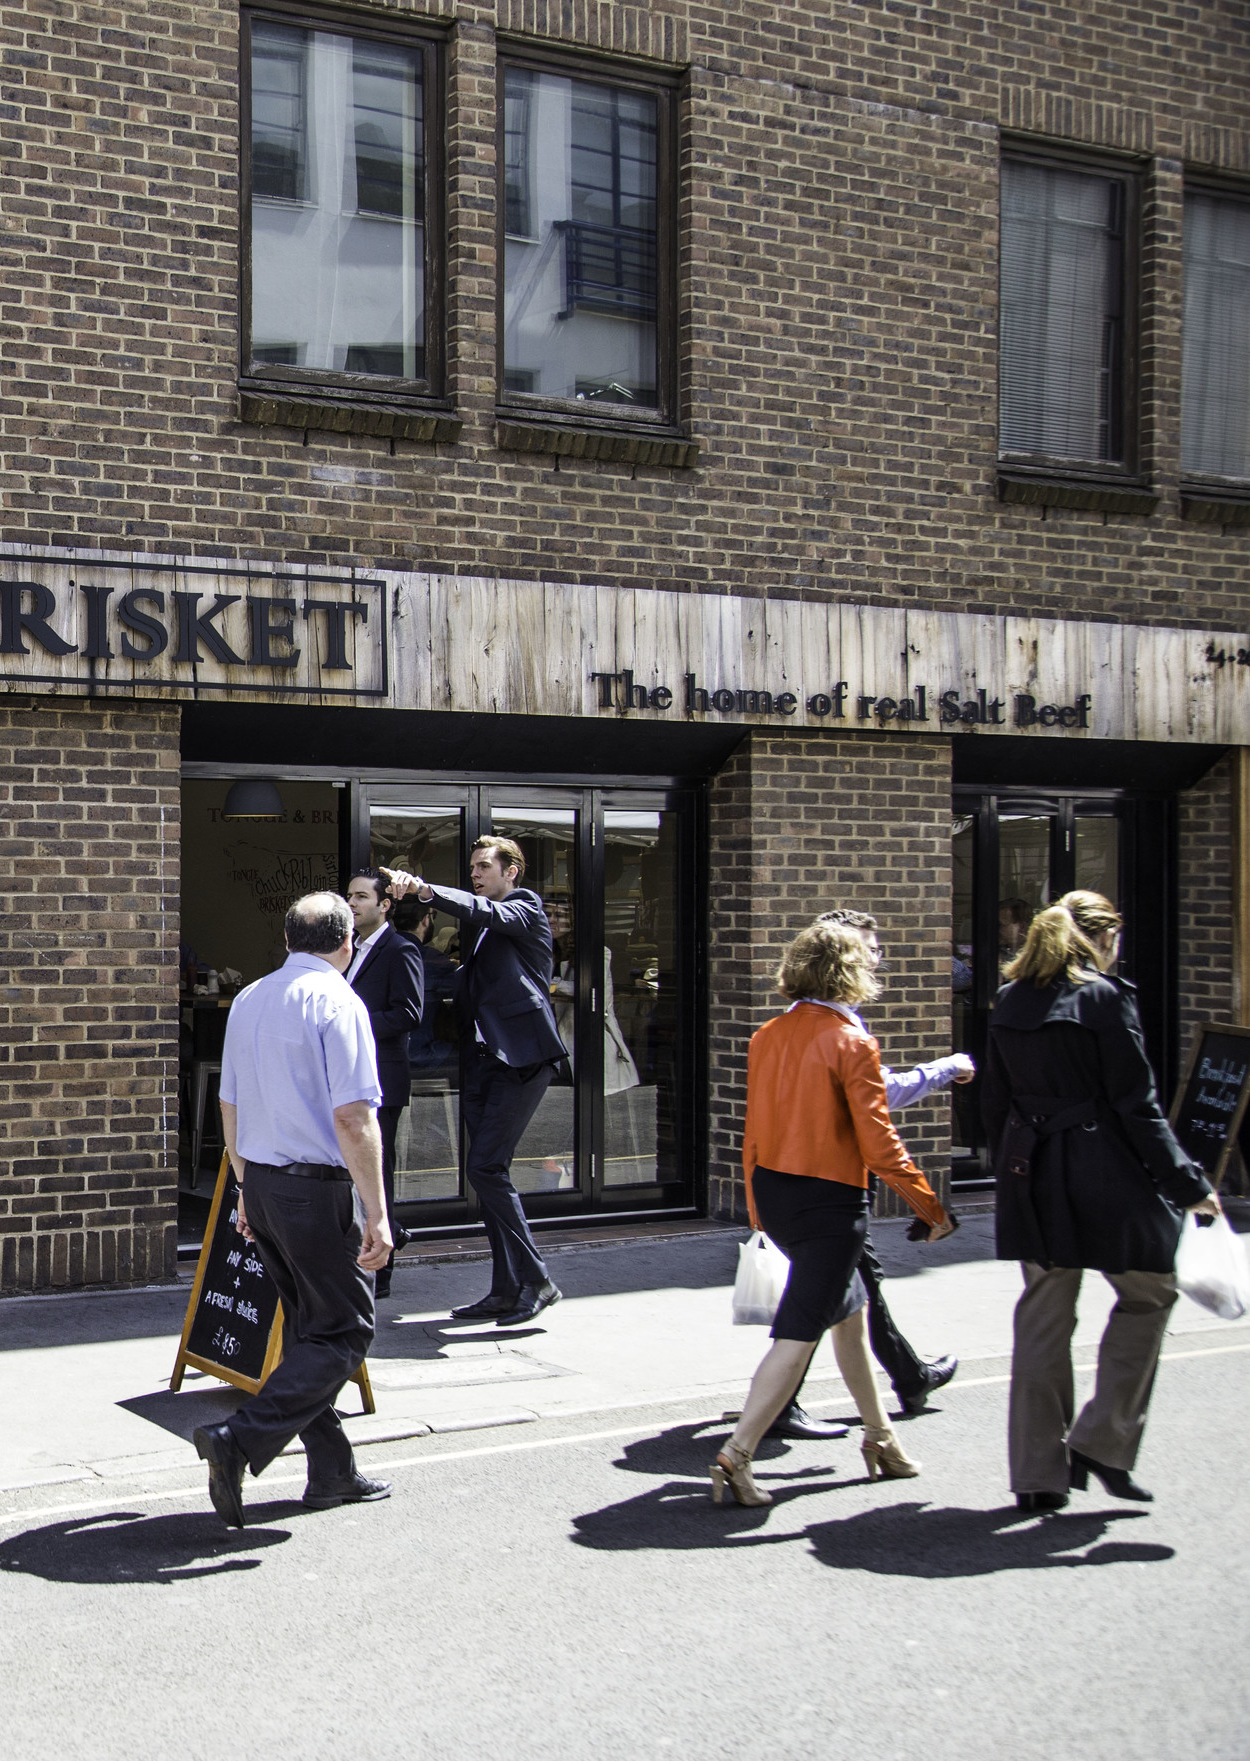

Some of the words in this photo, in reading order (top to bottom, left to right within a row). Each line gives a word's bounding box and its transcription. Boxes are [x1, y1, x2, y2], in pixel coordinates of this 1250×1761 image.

[591, 669, 673, 710] The
[684, 673, 798, 716] home
[806, 681, 848, 718] of
[858, 685, 930, 722] real
[939, 688, 1006, 725] Salt
[1014, 693, 1092, 729] Beef
[292, 809, 306, 824] &
